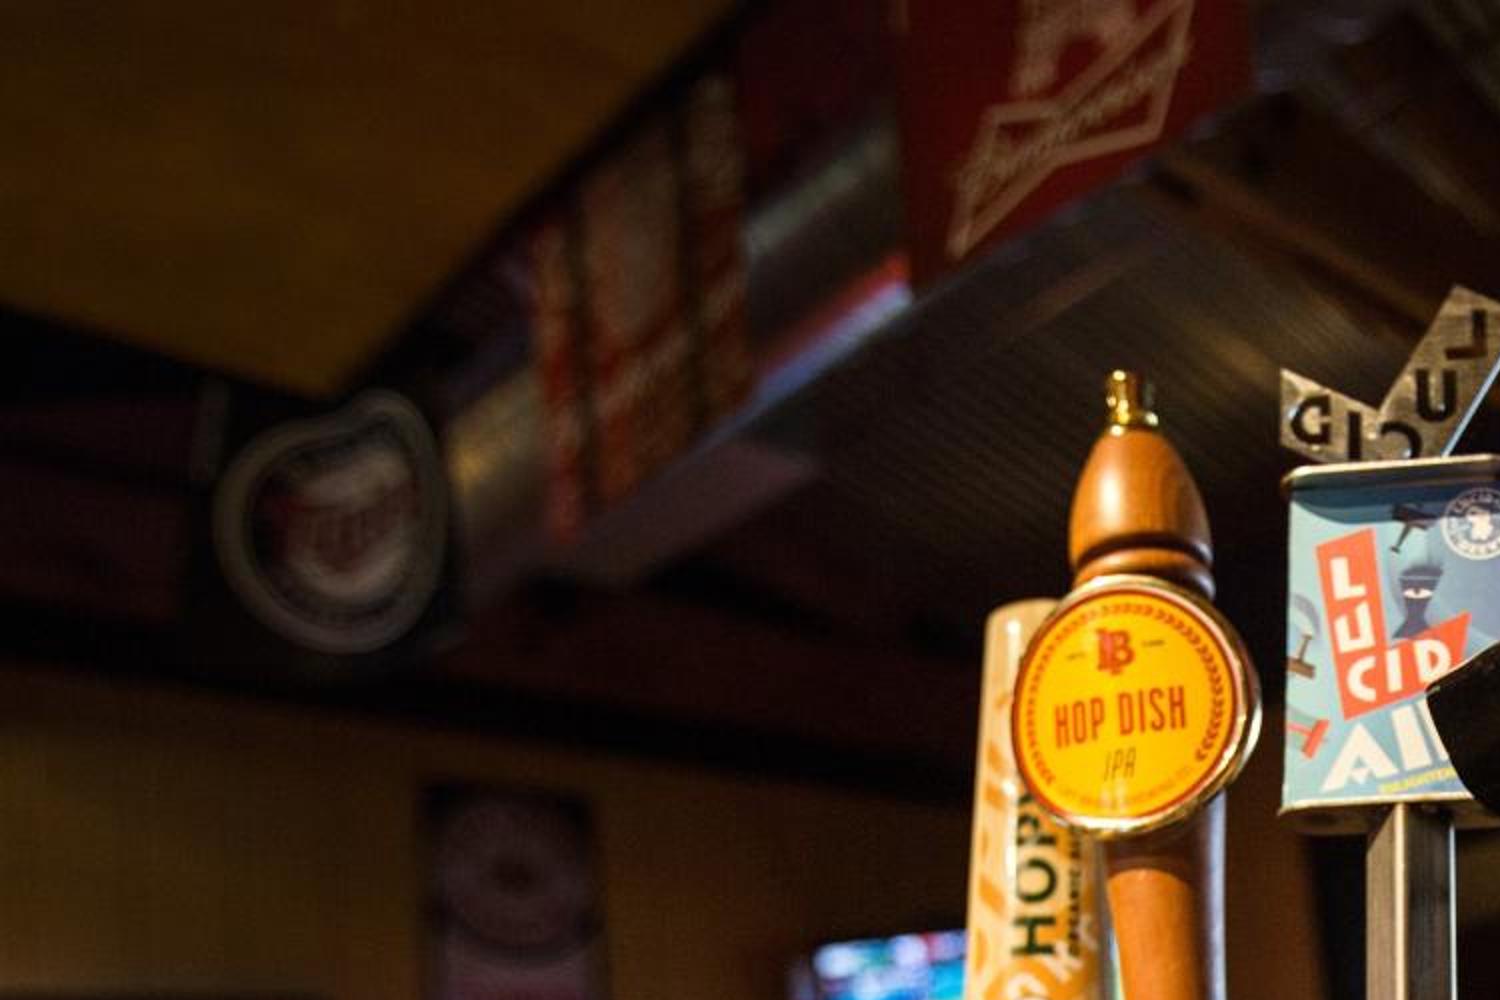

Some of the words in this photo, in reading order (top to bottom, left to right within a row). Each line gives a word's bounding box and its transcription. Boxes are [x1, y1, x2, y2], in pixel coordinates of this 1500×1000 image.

[1330, 556, 1452, 702] LUCID
[1054, 696, 1105, 749] HOP
[1117, 685, 1187, 737] DISH
[1320, 699, 1449, 792] AI
[1103, 746, 1137, 782] IPA
